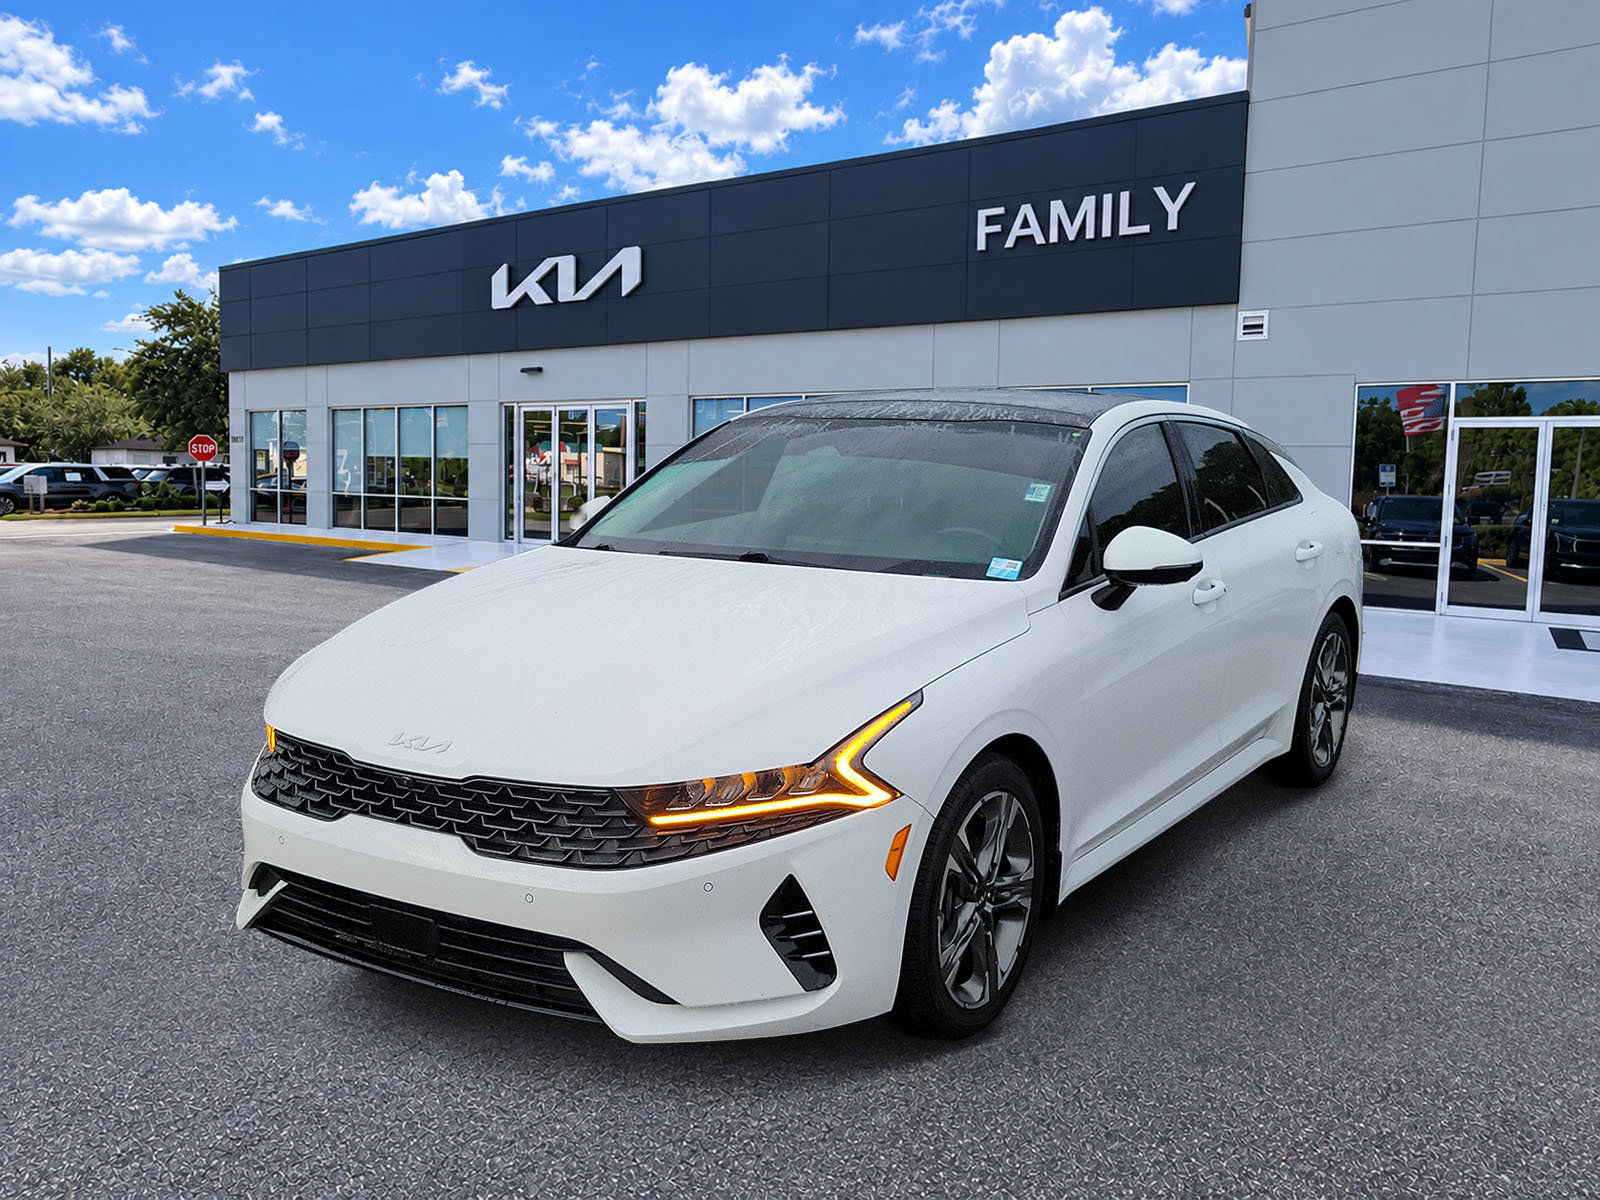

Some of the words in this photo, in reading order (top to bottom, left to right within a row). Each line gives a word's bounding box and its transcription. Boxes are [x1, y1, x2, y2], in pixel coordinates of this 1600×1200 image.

[977, 182, 1196, 251] FAMILY
[491, 246, 642, 310] KIA
[191, 443, 215, 454] STOP
[387, 731, 454, 754] KIA
